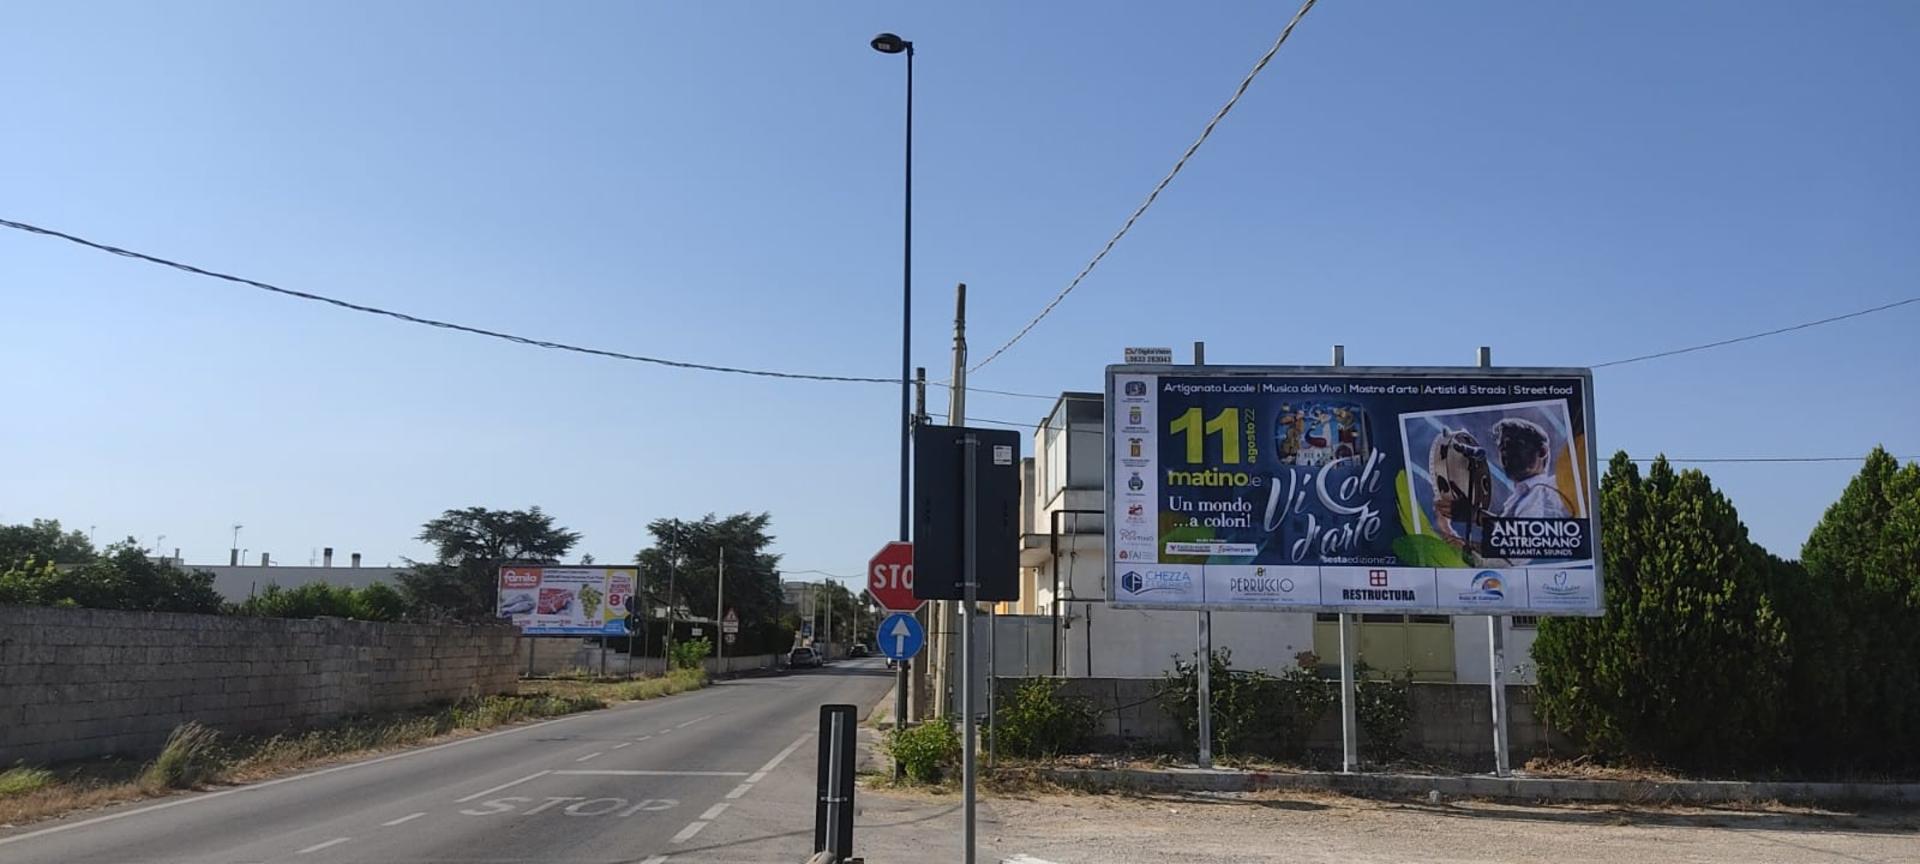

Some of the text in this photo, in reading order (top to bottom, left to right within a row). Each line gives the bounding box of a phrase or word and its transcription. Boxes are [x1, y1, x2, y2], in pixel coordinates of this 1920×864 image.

[1223, 383, 1256, 393] Locale
[1262, 384, 1300, 394] Musica
[1300, 384, 1318, 394] dal
[1318, 384, 1342, 394] Vivo
[1349, 384, 1386, 395] Mostre
[1386, 384, 1420, 395] d'arte
[1423, 384, 1460, 395] Artisti
[1460, 384, 1469, 394] di
[1469, 384, 1507, 395] Strada
[1513, 385, 1549, 395] Street
[1549, 385, 1574, 395] food
[1170, 407, 1240, 464] 11
[1169, 496, 1252, 512] Un mondo
[1204, 512, 1251, 528] colori!
[1491, 520, 1580, 537] ANTONIO
[503, 570, 537, 587] famila
[873, 563, 913, 590] STO
[1230, 578, 1295, 593] PERRUCCIO
[1342, 588, 1416, 601] RESTRUCTURA
[459, 796, 680, 817] STOP
